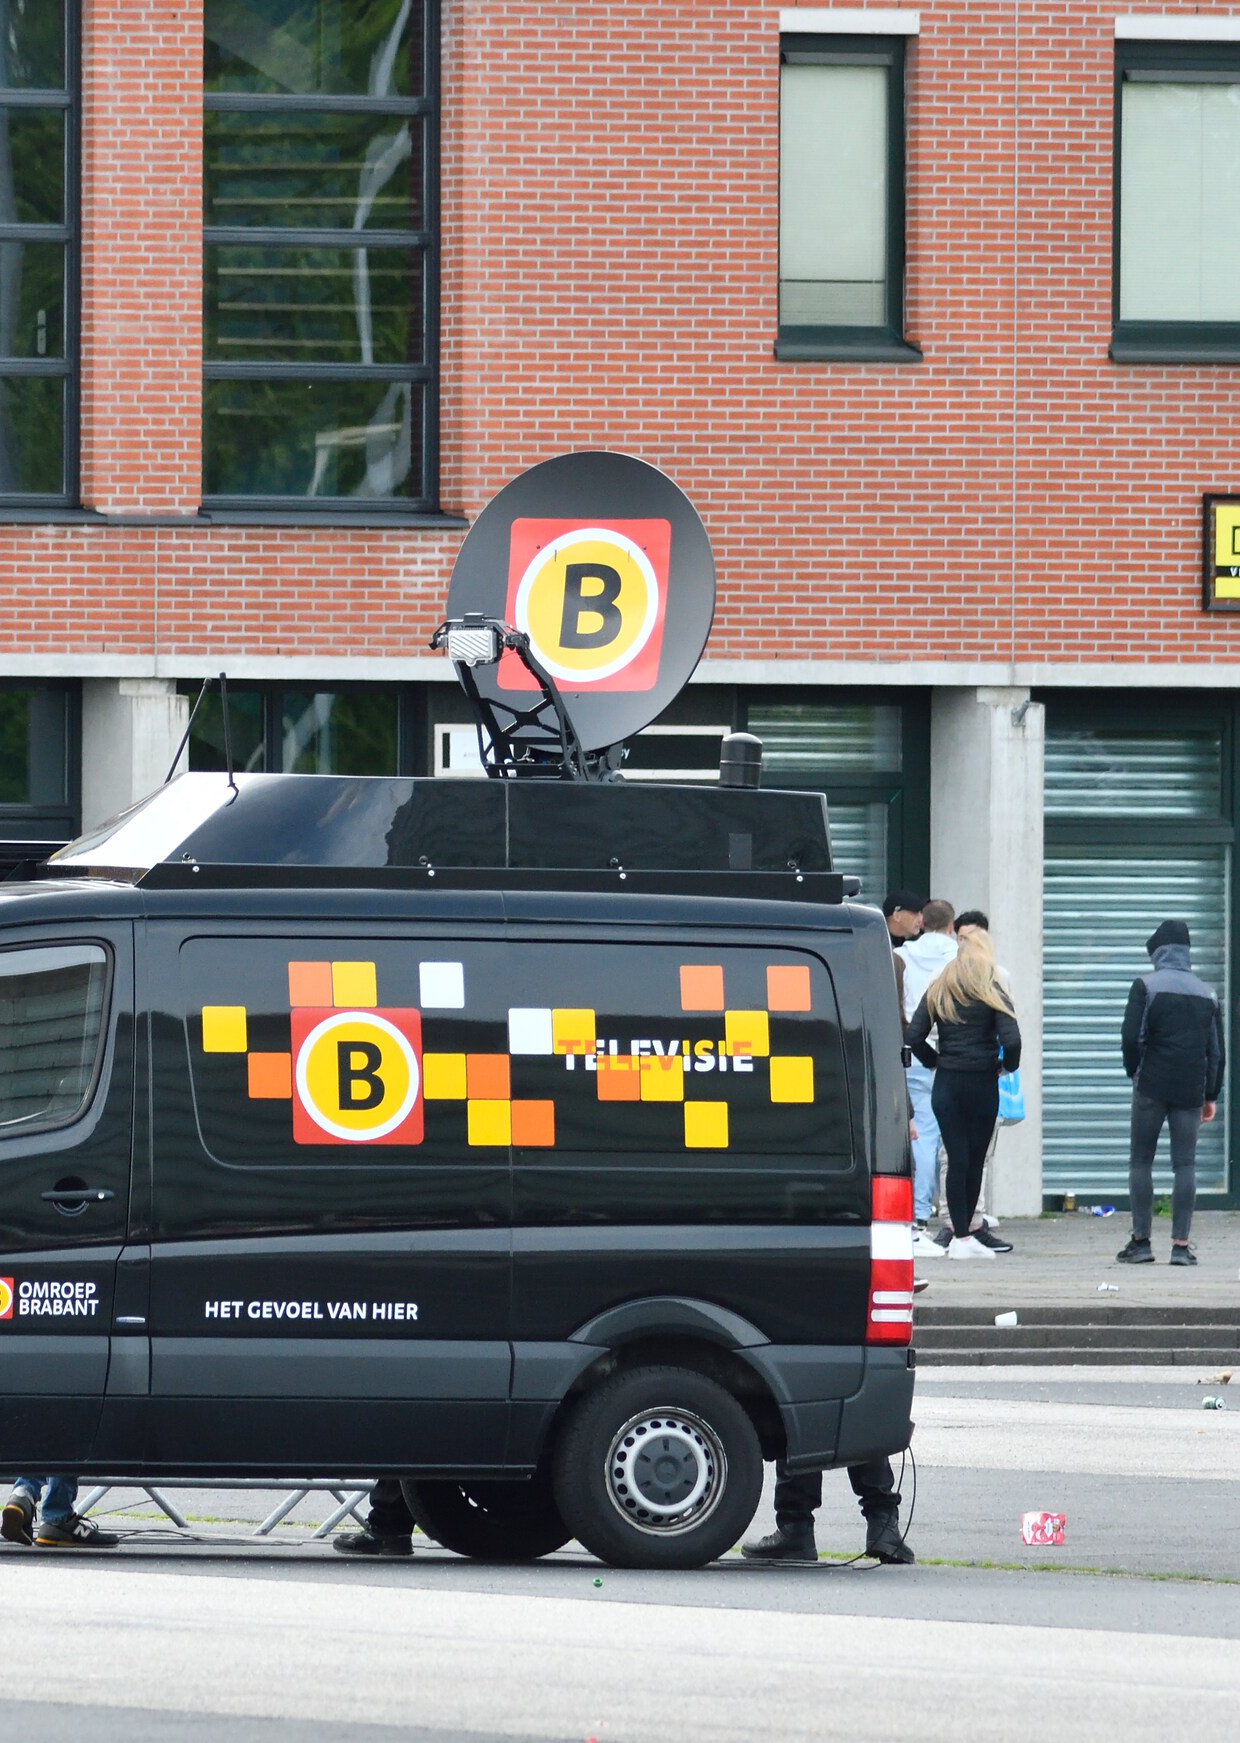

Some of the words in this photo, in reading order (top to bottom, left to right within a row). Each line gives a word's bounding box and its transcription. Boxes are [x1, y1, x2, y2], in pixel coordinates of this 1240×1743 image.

[558, 562, 623, 650] B
[557, 1039, 754, 1072] TELEVISIE
[337, 1041, 386, 1111] B
[18, 1281, 97, 1299] OMROEP
[18, 1299, 100, 1316] BRABANT
[205, 1301, 243, 1318] HET
[247, 1301, 323, 1319] GEVOEL
[327, 1302, 367, 1319] VAN
[372, 1303, 418, 1320] HIER
